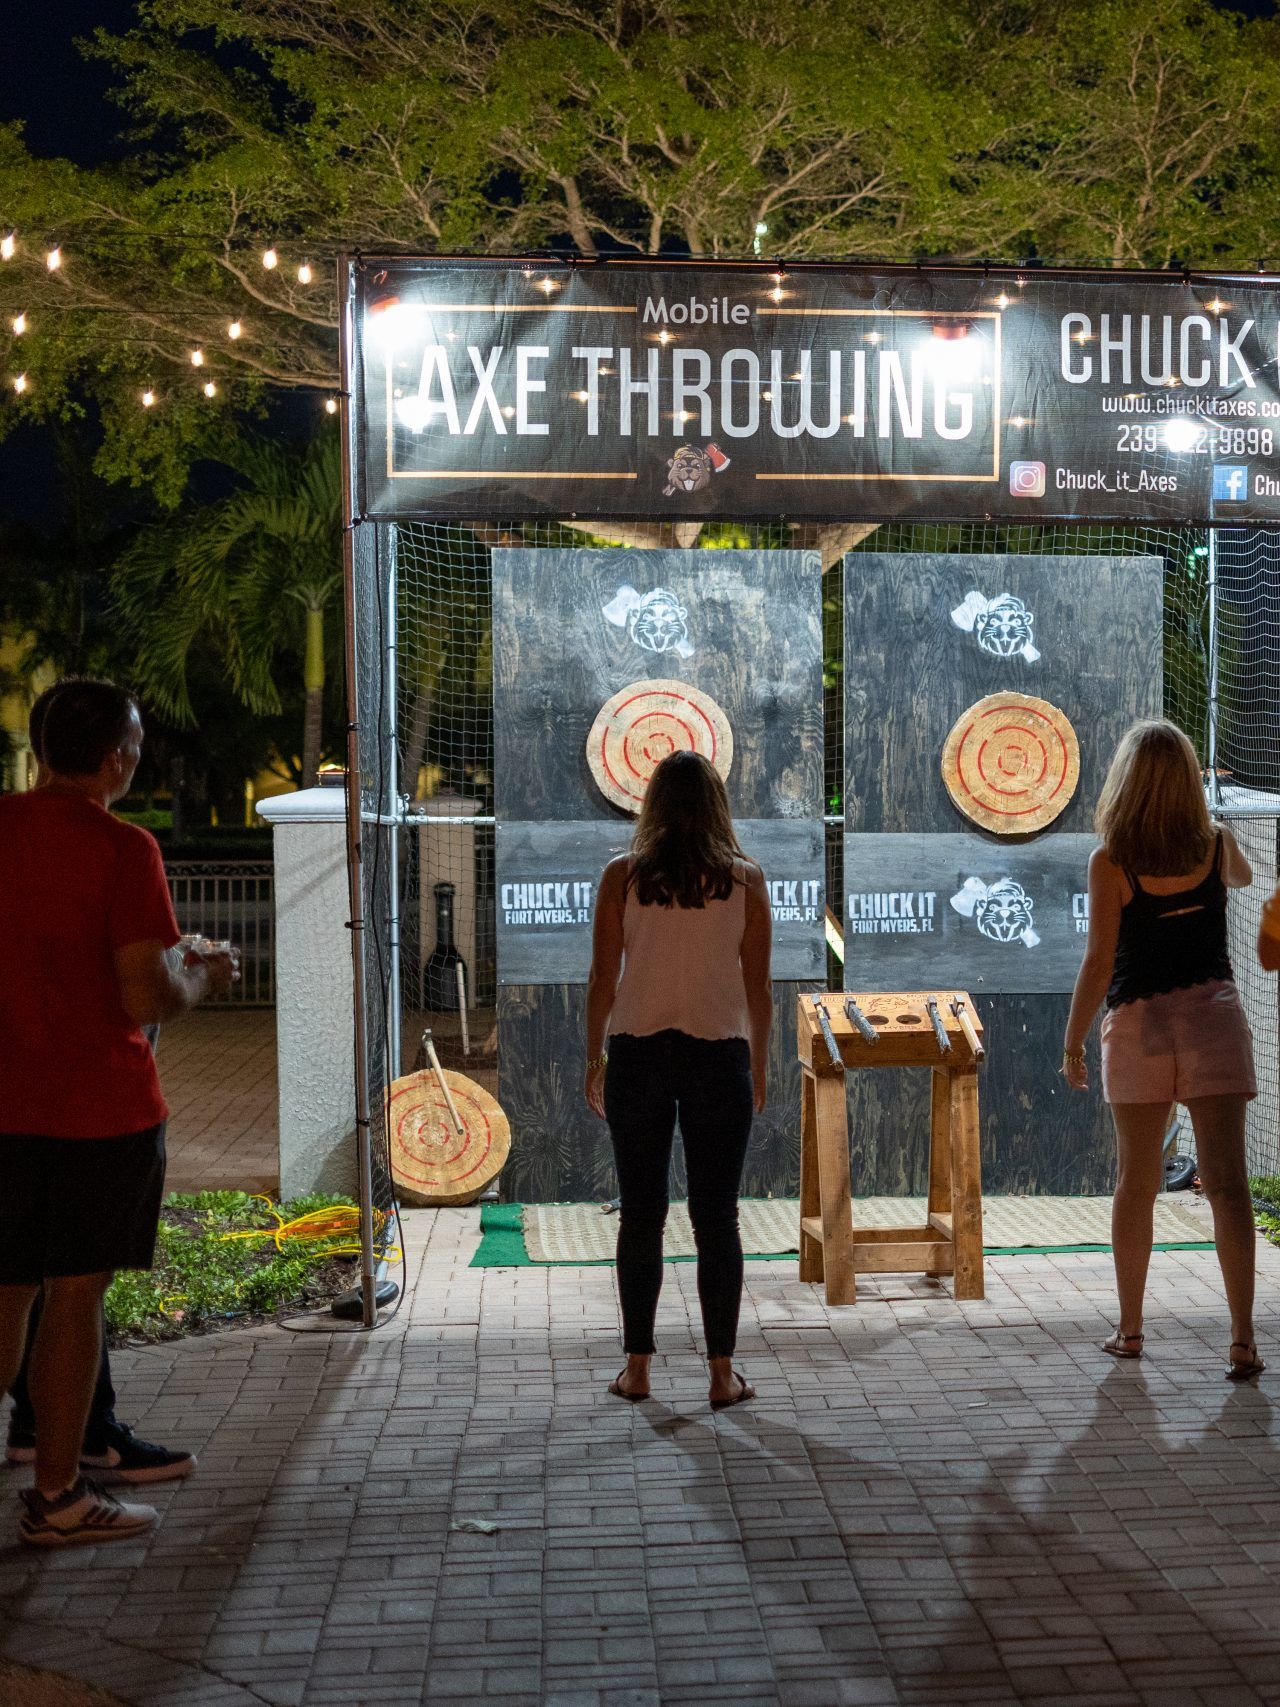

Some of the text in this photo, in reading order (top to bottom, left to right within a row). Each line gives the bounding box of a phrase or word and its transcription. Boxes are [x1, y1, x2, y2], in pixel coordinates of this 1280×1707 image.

[642, 296, 751, 325] Mobile
[1060, 312, 1257, 388] CHUCK
[412, 345, 973, 441] AXE THROWING
[1055, 468, 1178, 493] Chuck_it_Axes
[501, 881, 593, 910] CHUCK IT
[801, 880, 821, 906] IT
[848, 891, 937, 919] CHUCK IT
[505, 908, 590, 925] FORT MYERS, FL
[805, 907, 818, 921] FL
[852, 918, 935, 934] FORT MYERS, FL
